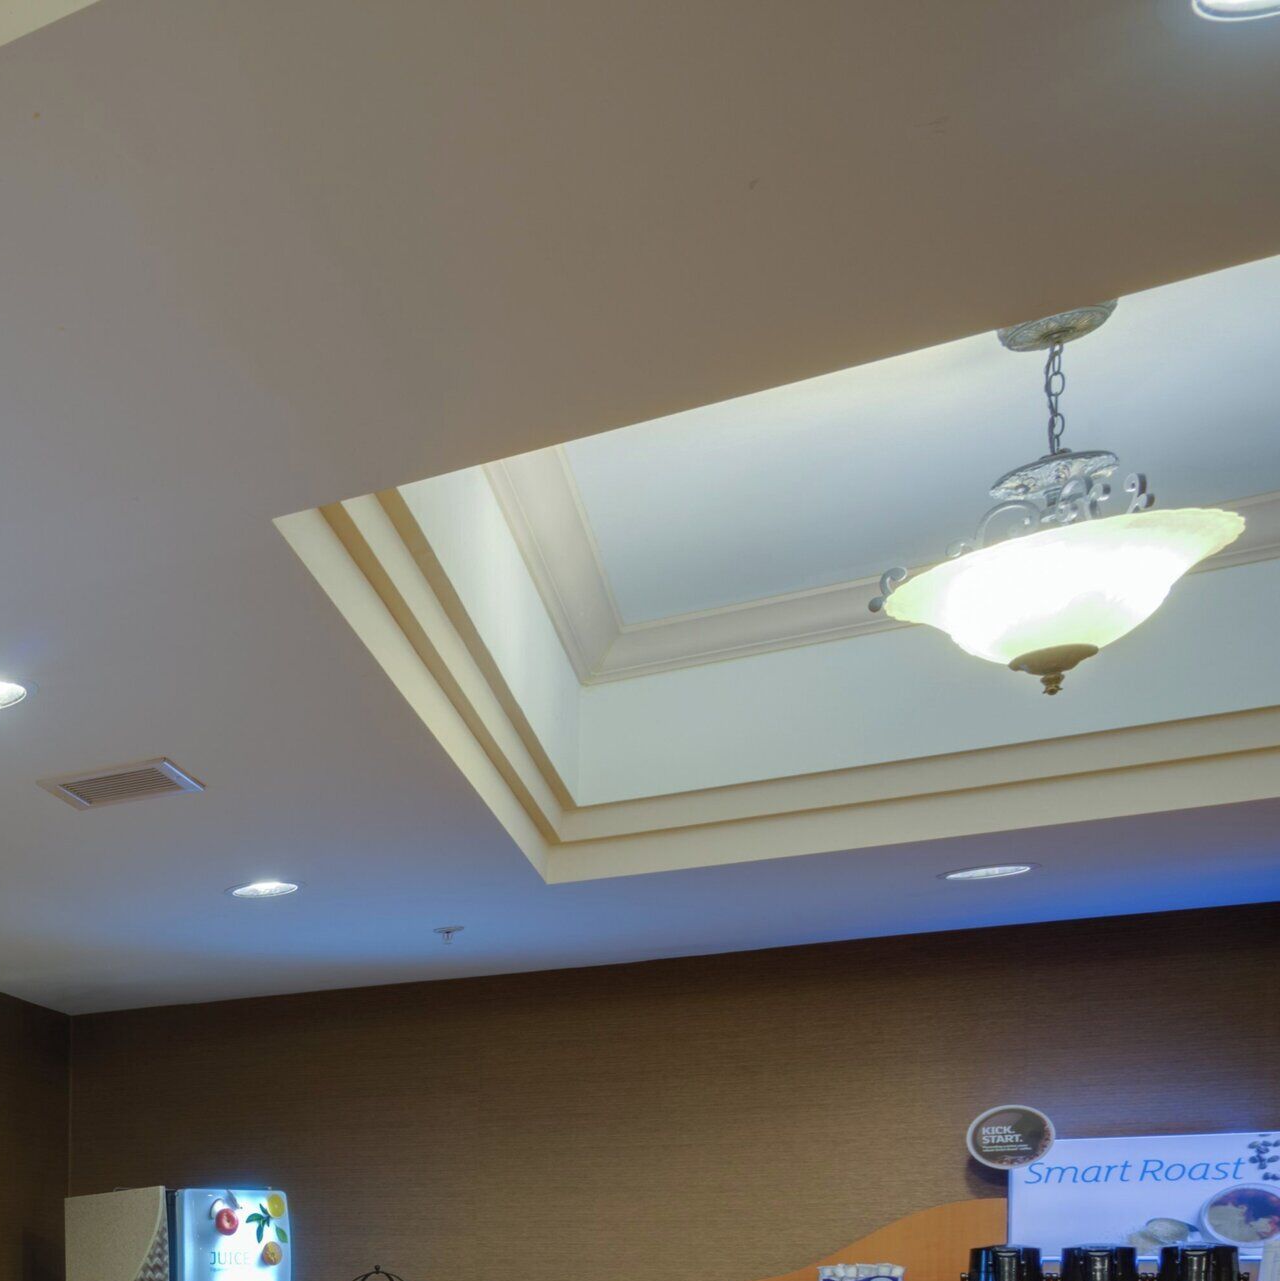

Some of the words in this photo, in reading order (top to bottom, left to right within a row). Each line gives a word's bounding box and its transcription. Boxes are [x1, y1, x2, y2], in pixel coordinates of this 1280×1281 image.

[982, 1125, 1016, 1135] KICK.
[982, 1134, 1024, 1144] START.
[1024, 1159, 1131, 1184] Smart
[1140, 1157, 1246, 1182] Roast
[209, 1251, 251, 1265] JUICE
